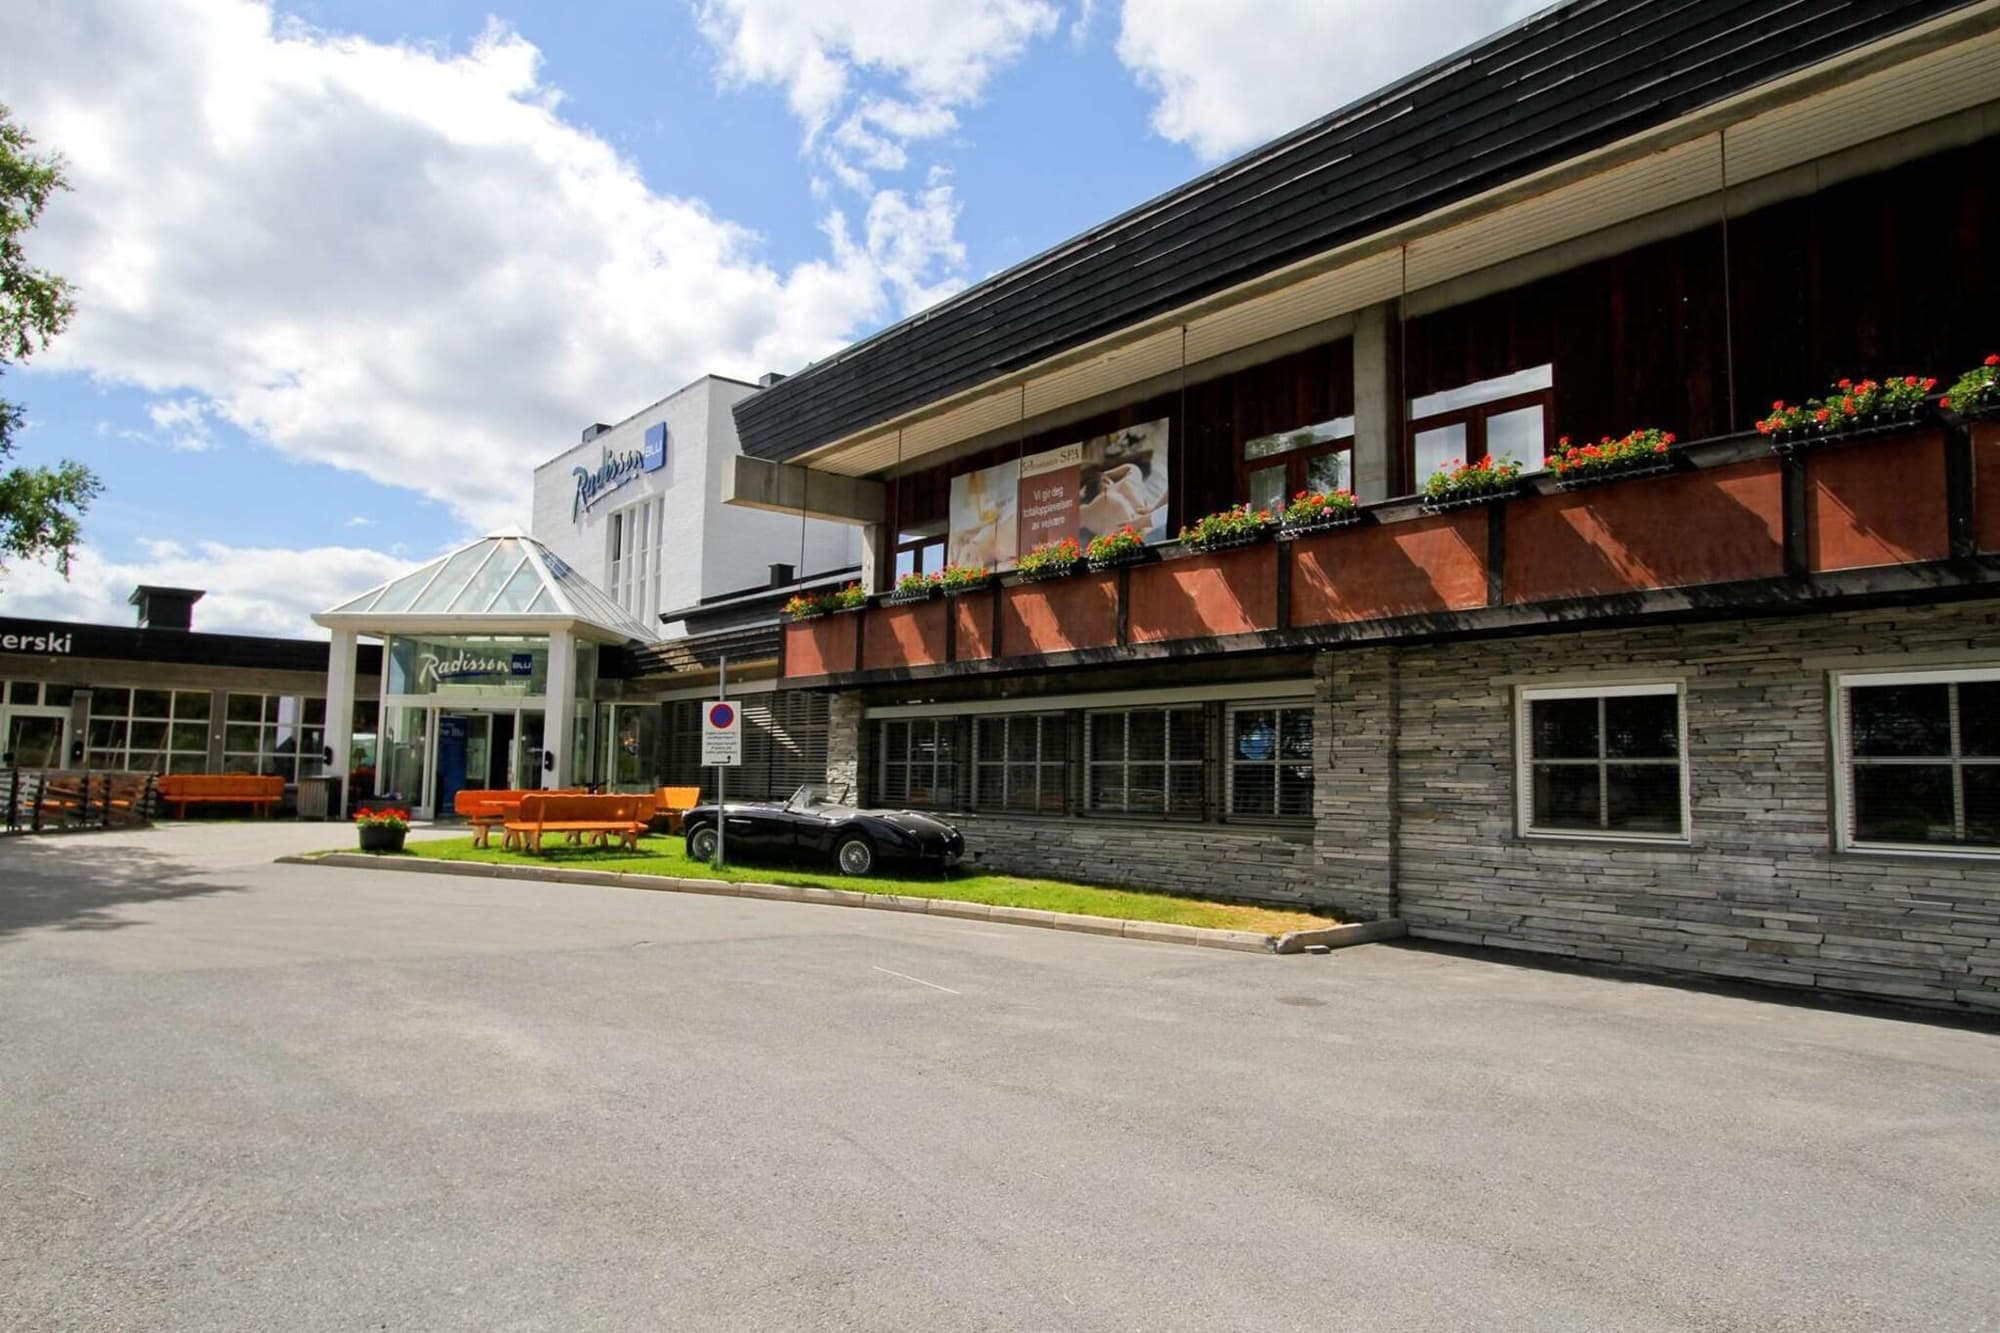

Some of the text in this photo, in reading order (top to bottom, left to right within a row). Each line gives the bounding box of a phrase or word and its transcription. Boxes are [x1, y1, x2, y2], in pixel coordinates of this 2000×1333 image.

[1060, 447, 1080, 463] SPA
[572, 440, 661, 524] Radisson BLU
[0, 632, 72, 653] erski
[419, 649, 531, 684] Radisson BLU
